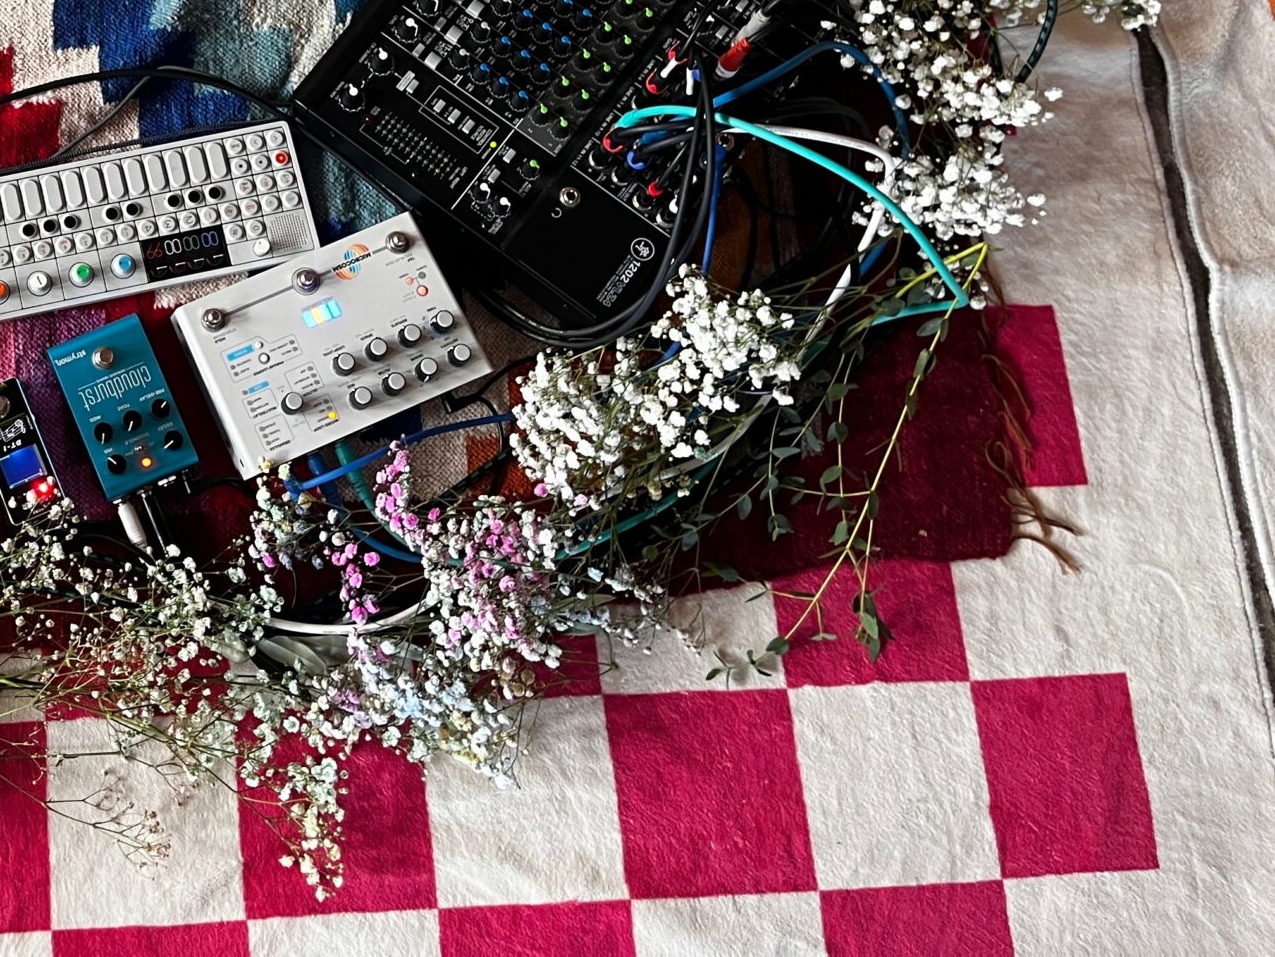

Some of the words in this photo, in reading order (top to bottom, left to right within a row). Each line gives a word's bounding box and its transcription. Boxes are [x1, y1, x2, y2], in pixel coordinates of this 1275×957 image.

[459, 165, 468, 176] LEFT
[449, 176, 460, 189] RIGHT
[163, 219, 172, 228] 3
[183, 214, 193, 224] 2
[143, 224, 151, 232] 4
[182, 234, 199, 251] 00
[200, 230, 218, 247] 00
[145, 242, 162, 259] 99
[163, 238, 181, 255] 00
[332, 251, 372, 274] MICROCOSM
[214, 335, 225, 344] HOLD
[322, 348, 333, 357] LEVEL
[333, 344, 344, 352] LOOP
[54, 349, 87, 367] strymon
[78, 364, 152, 414] cloudburst
[138, 388, 165, 402] PRE-DELAY
[117, 402, 130, 412] TONE
[252, 406, 276, 417] MULTIDELAY
[89, 414, 102, 424] MOD
[324, 417, 338, 426] MICRO
[313, 424, 324, 432] LOOP
[2, 439, 23, 452] DT-1
[103, 446, 113, 455] MIX
